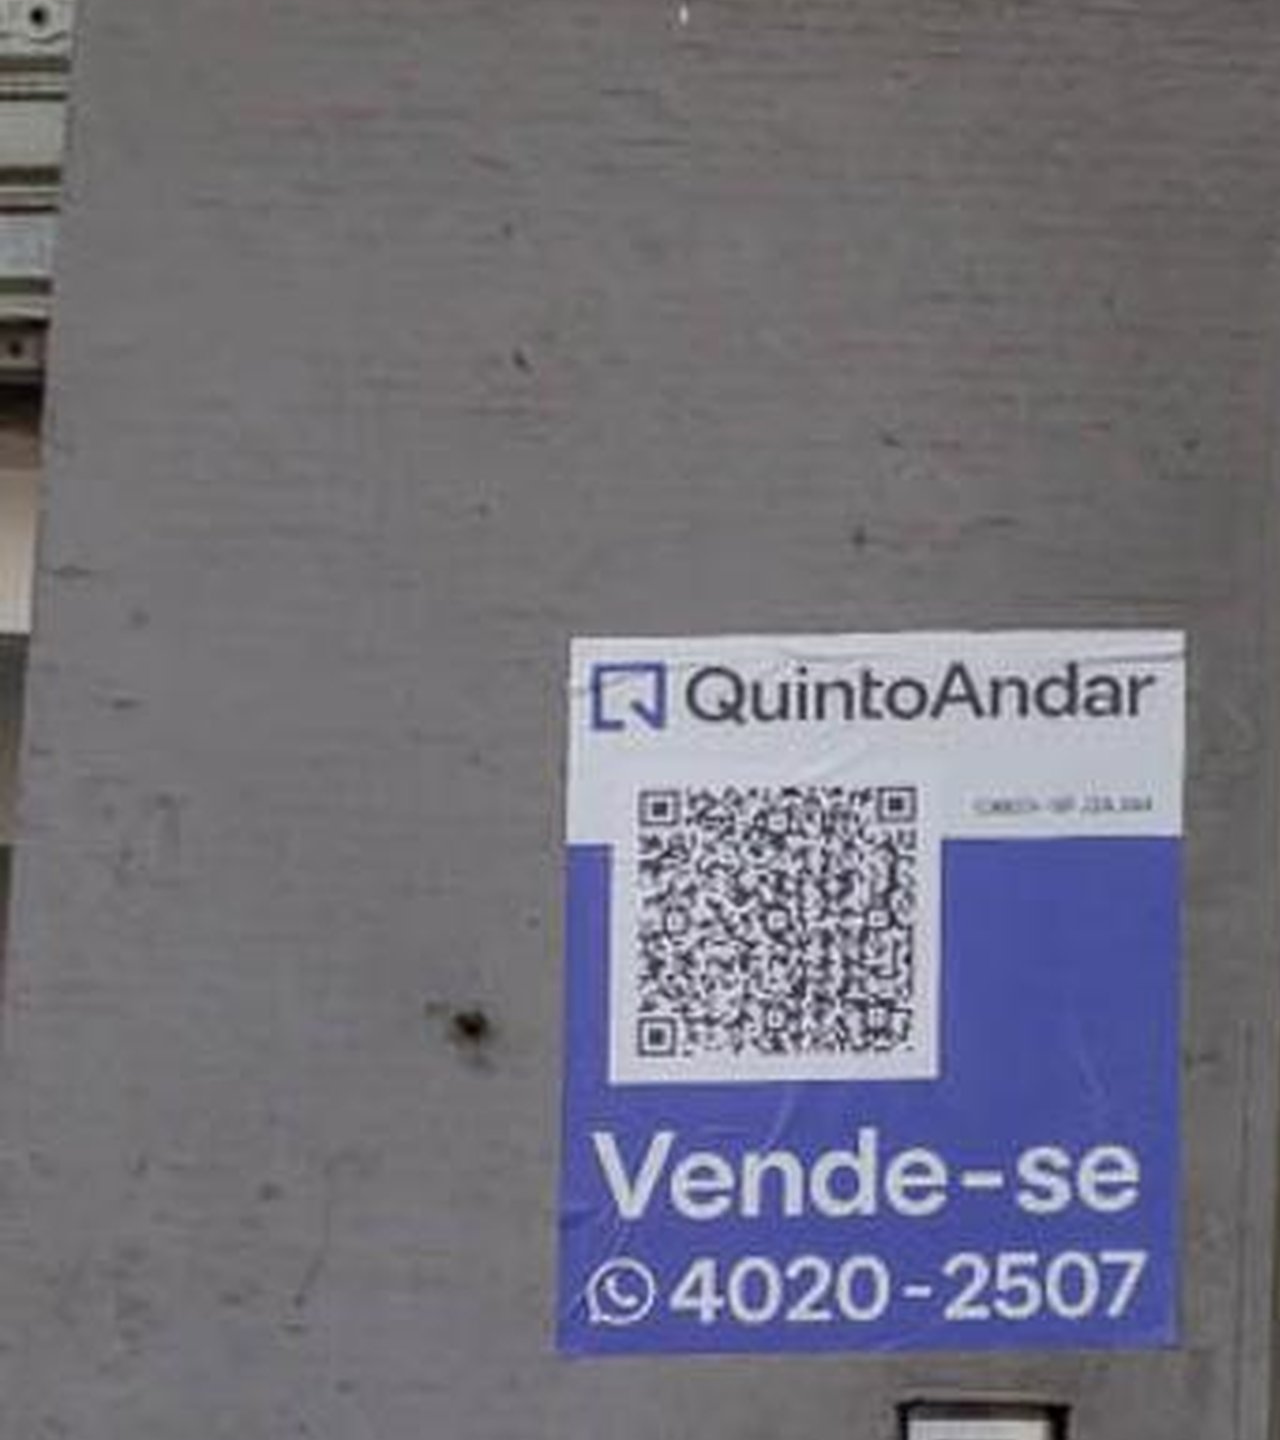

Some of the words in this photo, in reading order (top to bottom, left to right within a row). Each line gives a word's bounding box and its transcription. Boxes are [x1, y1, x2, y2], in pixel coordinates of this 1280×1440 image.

[685, 662, 1156, 726] QuintoAndar
[590, 1127, 1141, 1221] Vende-se
[669, 1250, 1149, 1325] 4020-2507
